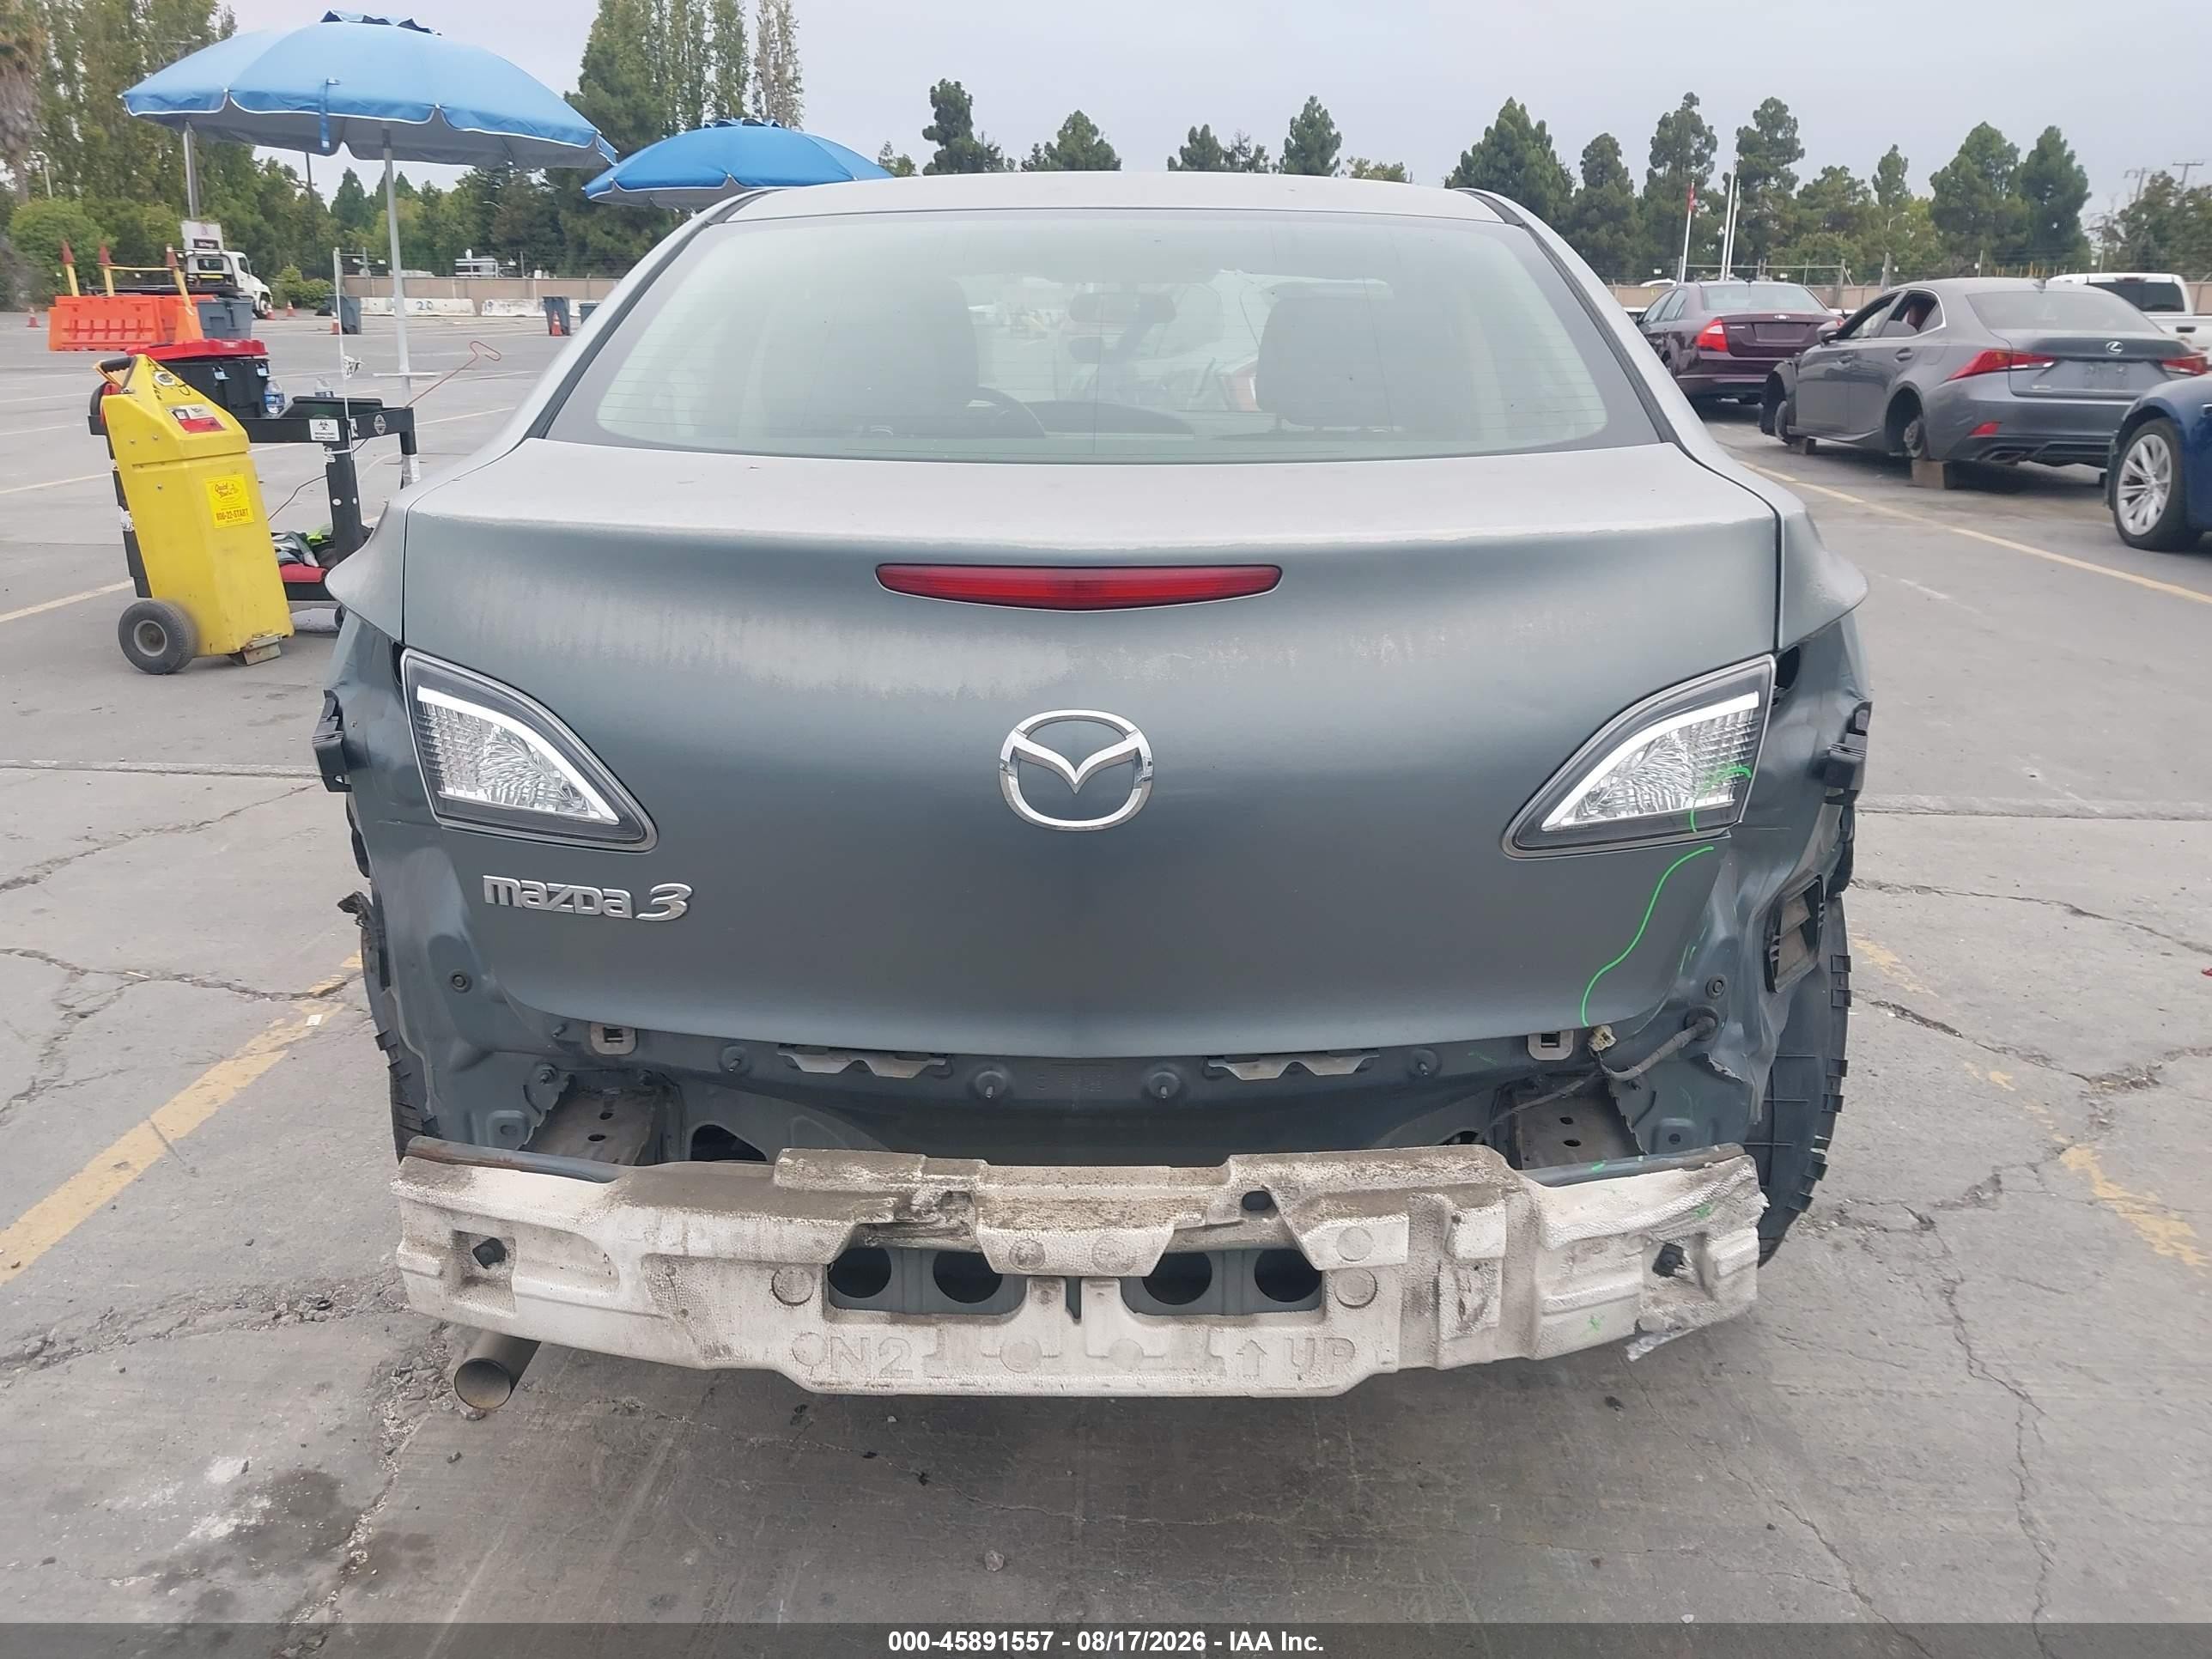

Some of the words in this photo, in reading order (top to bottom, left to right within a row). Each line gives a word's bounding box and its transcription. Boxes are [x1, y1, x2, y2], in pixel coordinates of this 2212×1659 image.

[416, 301, 434, 311] 20
[635, 882, 693, 921] 3
[1283, 1336, 1356, 1377] UP
